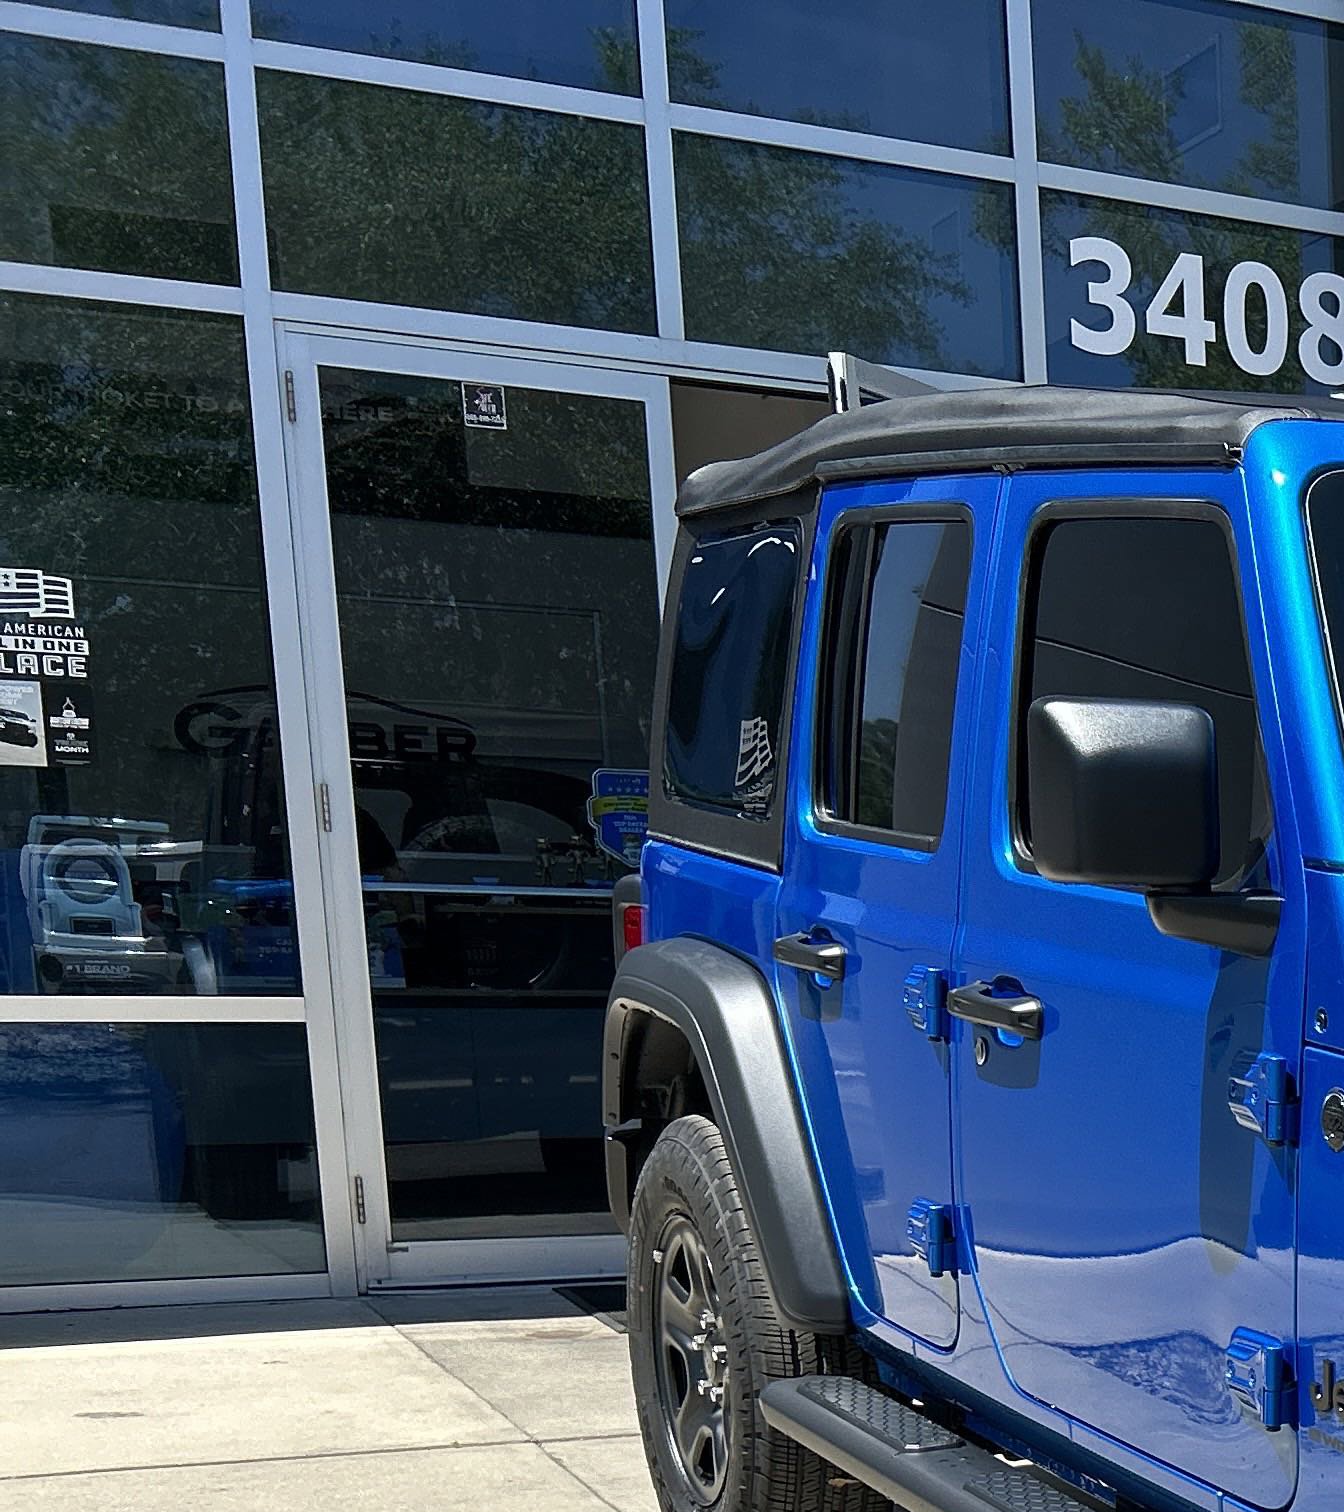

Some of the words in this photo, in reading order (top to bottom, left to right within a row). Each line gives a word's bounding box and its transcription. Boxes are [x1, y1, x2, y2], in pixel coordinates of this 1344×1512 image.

[3, 622, 86, 639] AMERICAN
[14, 638, 36, 651] IN
[43, 640, 86, 653] ONE
[83, 964, 131, 976] BRAND
